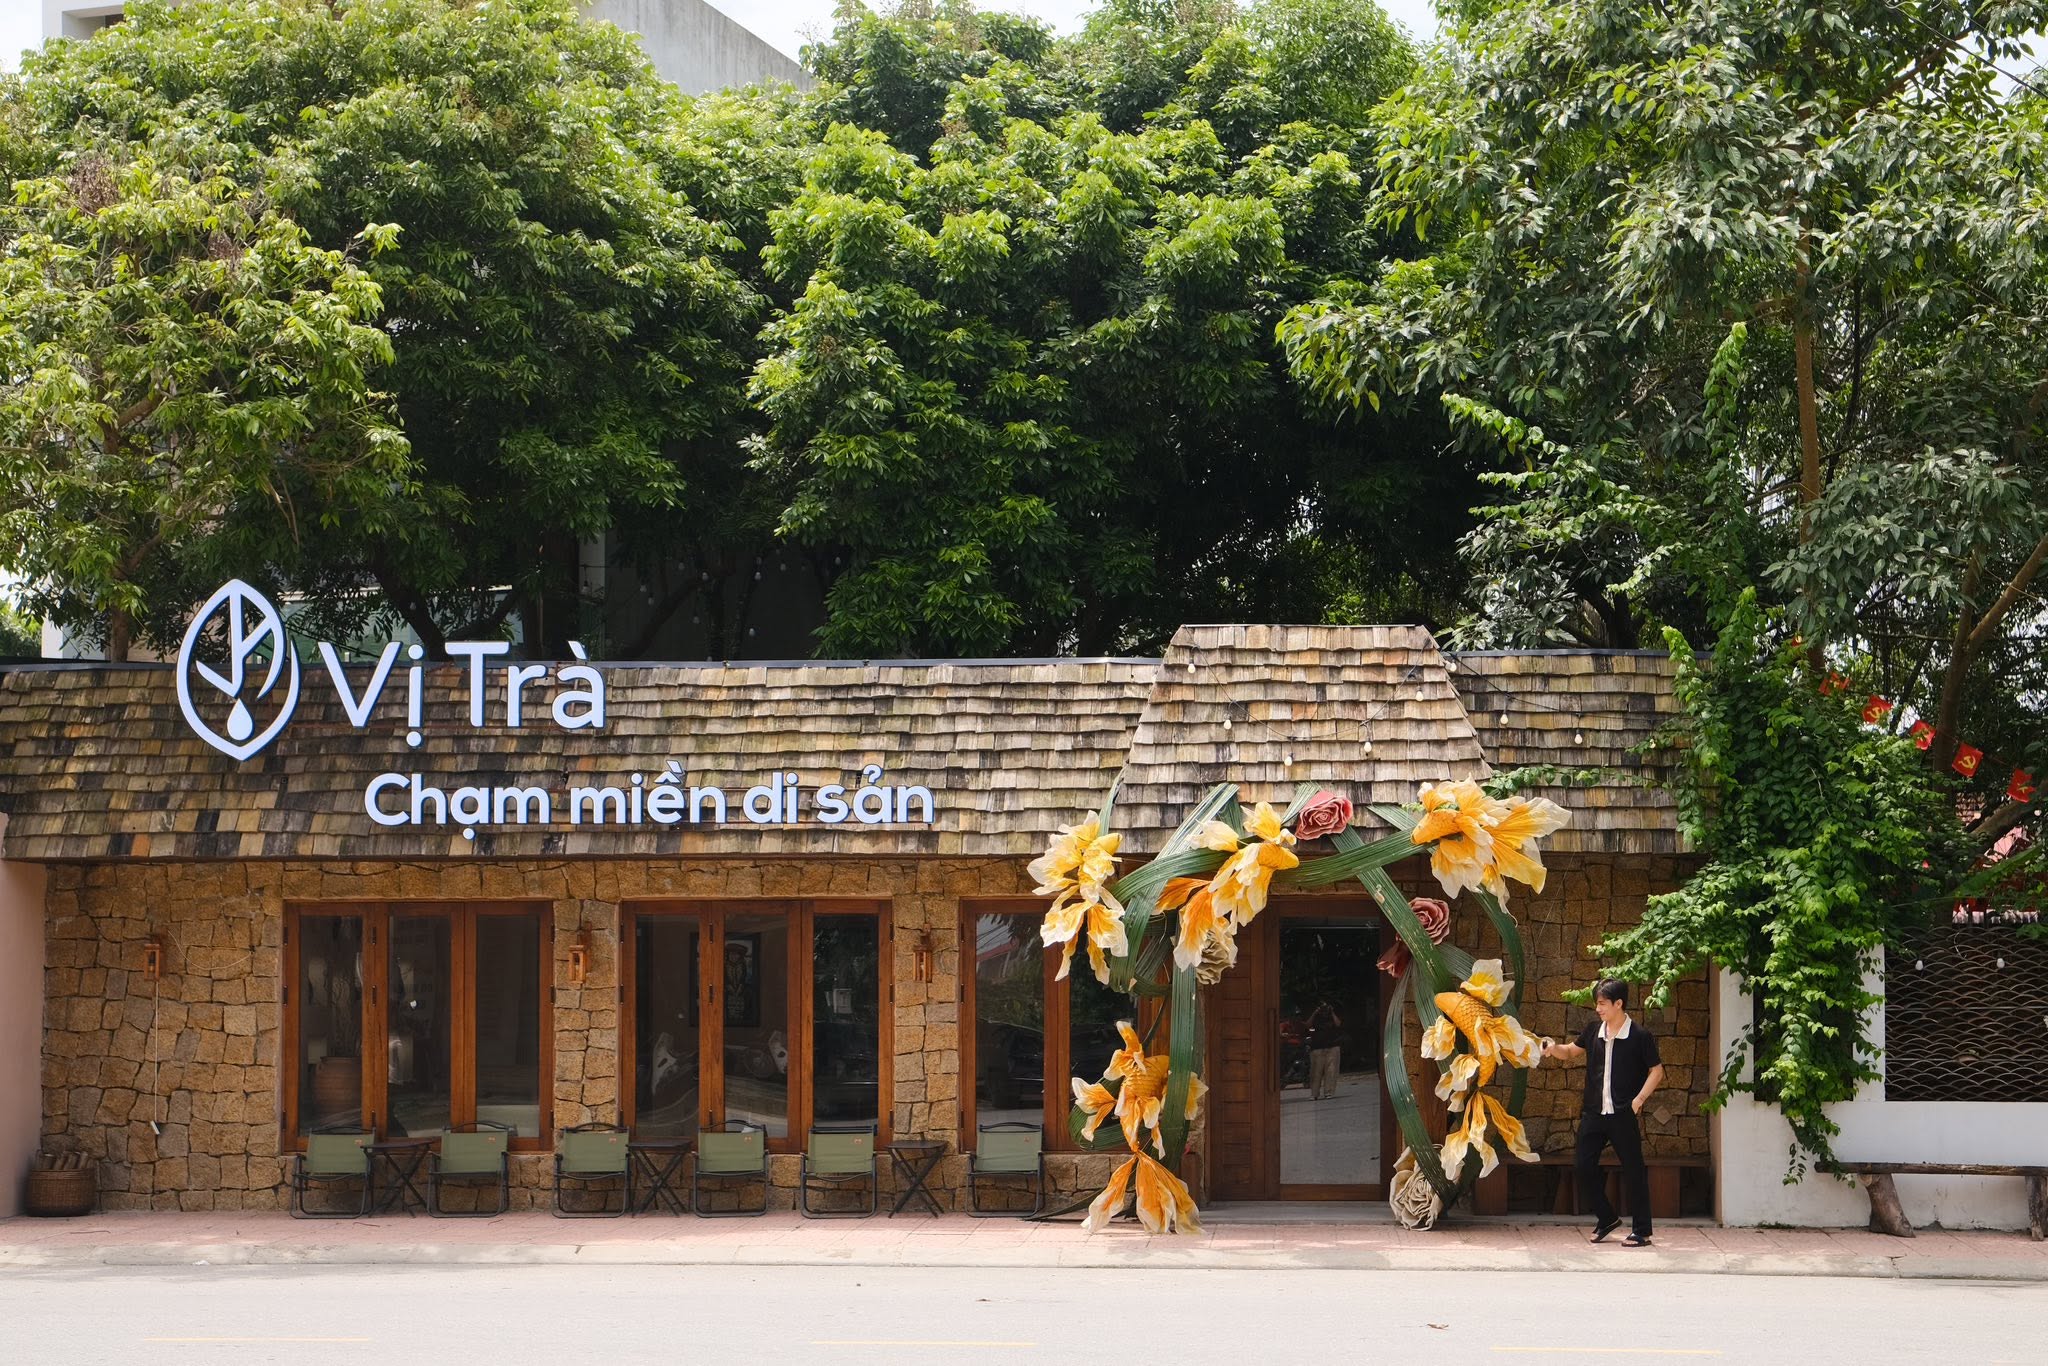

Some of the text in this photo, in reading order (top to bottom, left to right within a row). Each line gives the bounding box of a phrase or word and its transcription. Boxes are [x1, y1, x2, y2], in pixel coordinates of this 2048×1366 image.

[318, 640, 607, 748] Vị Trà
[364, 760, 934, 841] Chạm miền di sản
